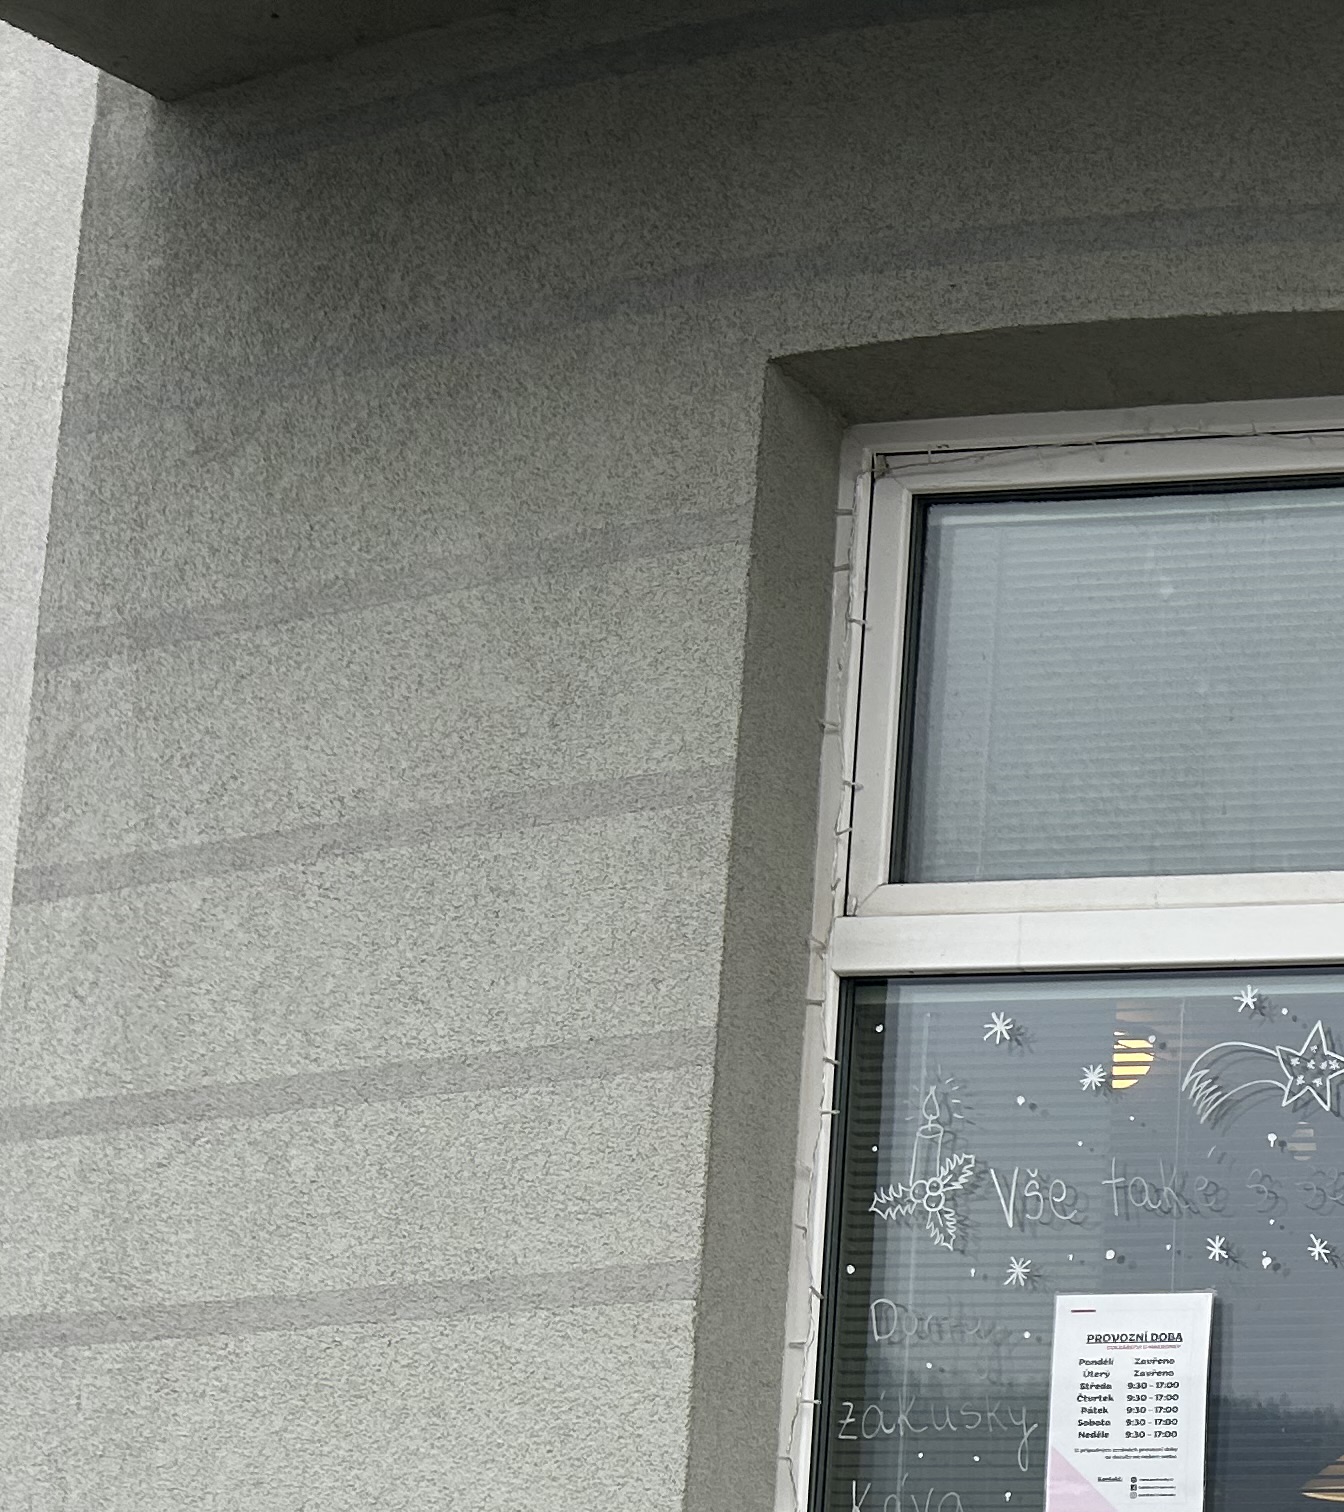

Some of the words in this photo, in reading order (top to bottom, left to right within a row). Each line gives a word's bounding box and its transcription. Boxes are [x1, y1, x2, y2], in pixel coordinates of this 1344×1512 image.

[990, 1166, 1077, 1228] Vše
[1086, 1331, 1148, 1343] PROVOZNÍ
[1151, 1333, 1183, 1342] DOBA
